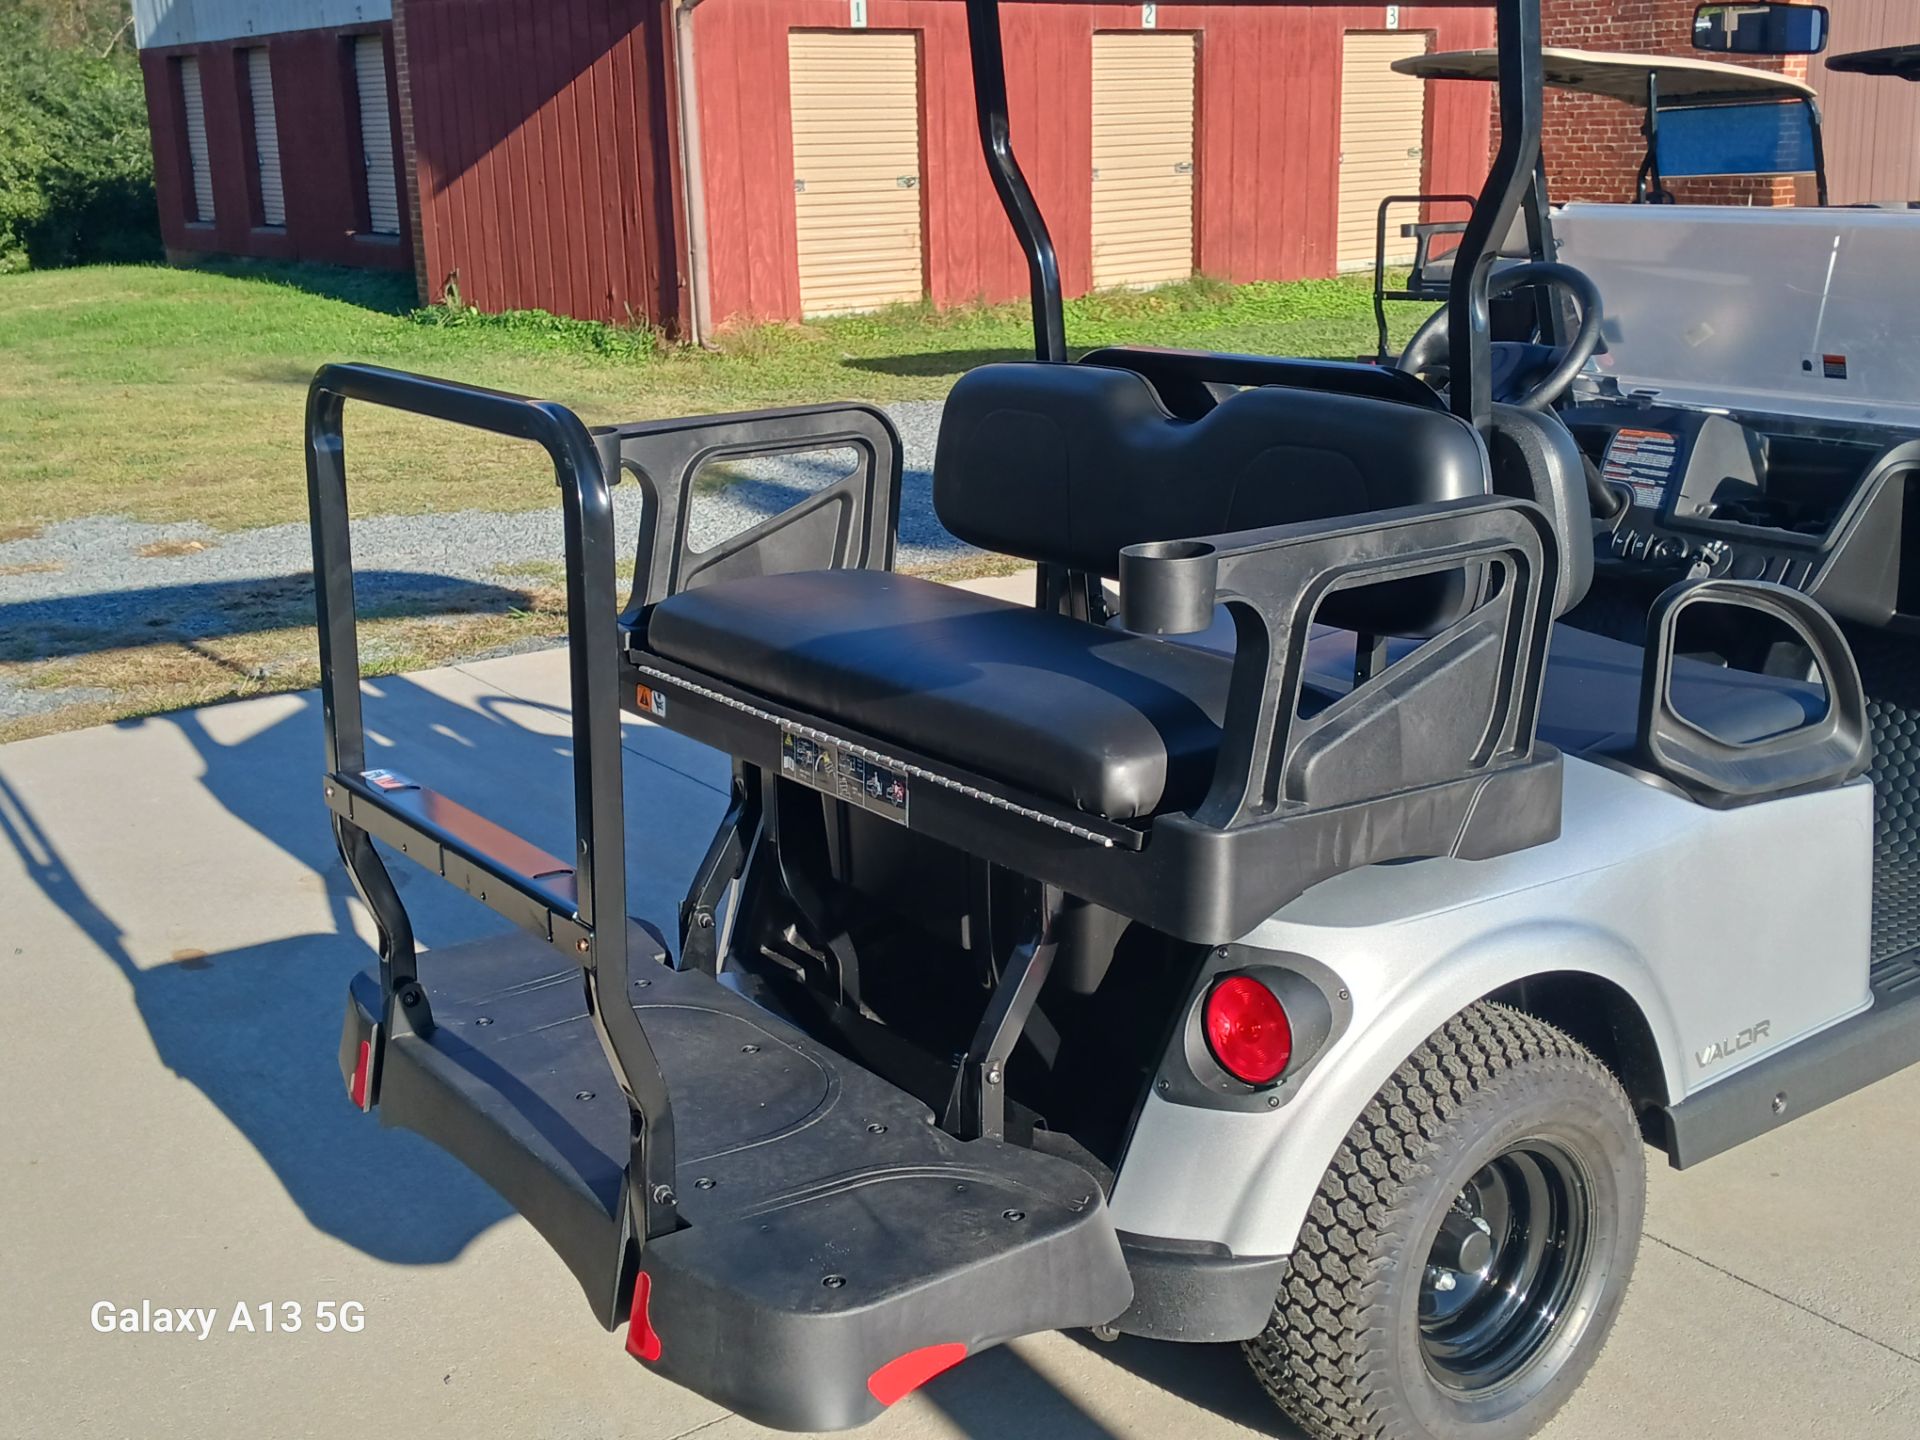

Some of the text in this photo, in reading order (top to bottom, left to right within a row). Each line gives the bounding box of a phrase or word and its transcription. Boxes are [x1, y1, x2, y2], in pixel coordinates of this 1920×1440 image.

[855, 1, 862, 22] 1
[1145, 4, 1153, 24] 2
[1389, 7, 1397, 25] 3
[1695, 1019, 1770, 1068] VALOR
